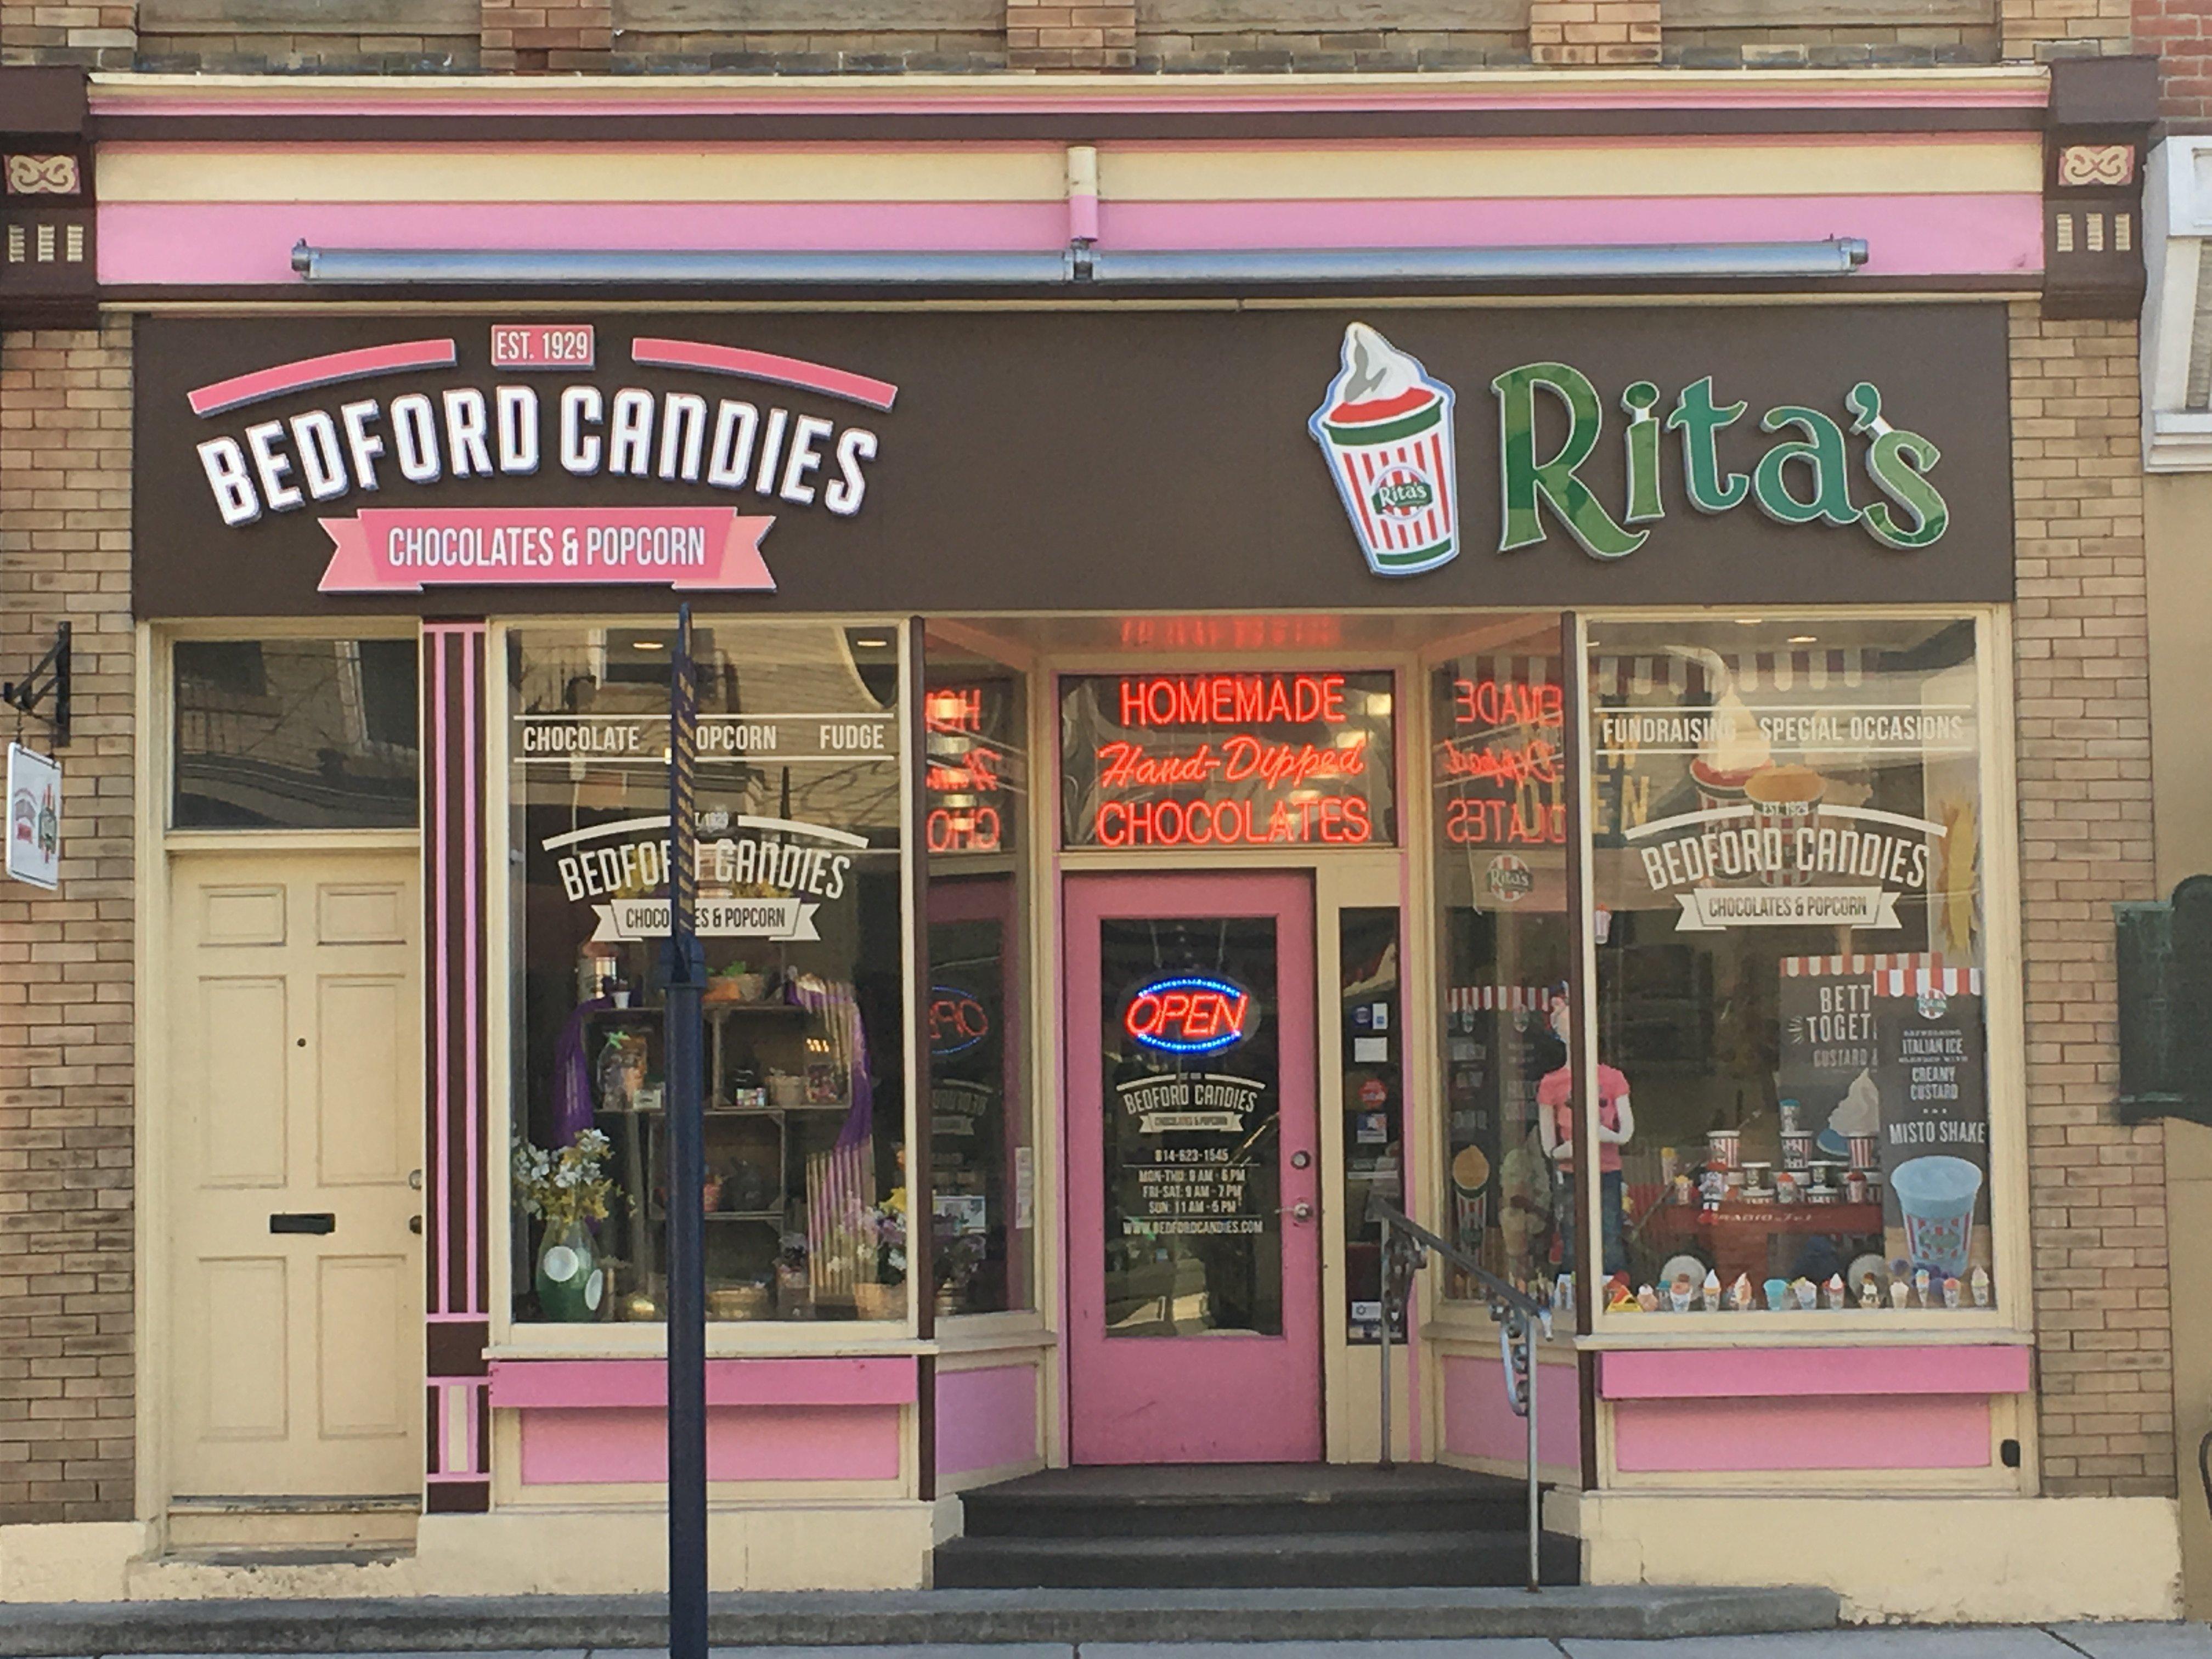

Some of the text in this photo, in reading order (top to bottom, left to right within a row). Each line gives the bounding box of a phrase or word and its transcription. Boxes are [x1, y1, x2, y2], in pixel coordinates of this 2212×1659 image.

[496, 330, 589, 360] EST. 1929
[196, 386, 878, 526] BEDFORD CANDIES
[1491, 362, 1949, 561] Rita's
[1379, 482, 1427, 507] Rita's
[388, 526, 705, 567] CHOCOLATES & POPCORN
[1120, 675, 1346, 726] HOMEMADE
[523, 725, 884, 752] CHOCOLATE OPCORN FUDGE
[1603, 718, 1736, 743] FUNDRAISING
[1760, 716, 1841, 742] SPECIAL
[1850, 715, 1963, 741] OCCASIONS
[1097, 735, 1366, 790] Hand-Dipped
[1098, 795, 1371, 847] CHOCOLATES
[1785, 802, 1808, 815] 1929
[558, 838, 851, 901] BEDFO CANDIES
[1641, 828, 1930, 890] BEDFORD CANDIES
[1491, 869, 1529, 887] Rita's
[626, 907, 785, 929] CHOCOES & POPCORN
[1709, 895, 1866, 917] CHOCOLATES & POPCORN
[1820, 985, 1871, 1013] BETT
[1125, 993, 1248, 1037] OPEN
[1814, 1048, 1867, 1068] CUSTARD
[1902, 1037, 1963, 1054] ITALIAN ICE
[1912, 1066, 1956, 1082] CREAMY
[1124, 1085, 1257, 1114] BEDFORD CANDIES
[1910, 1084, 1959, 1101] CUSTARD
[1889, 1121, 1985, 1144] MISTO SHAKE
[1198, 1169, 1214, 1181] AM
[1229, 1169, 1245, 1181] PM
[1194, 1185, 1210, 1198] AM
[1218, 1184, 1224, 1198] 7
[1226, 1184, 1243, 1198] PM
[1188, 1200, 1204, 1213] AM
[1221, 1200, 1236, 1213] PM
